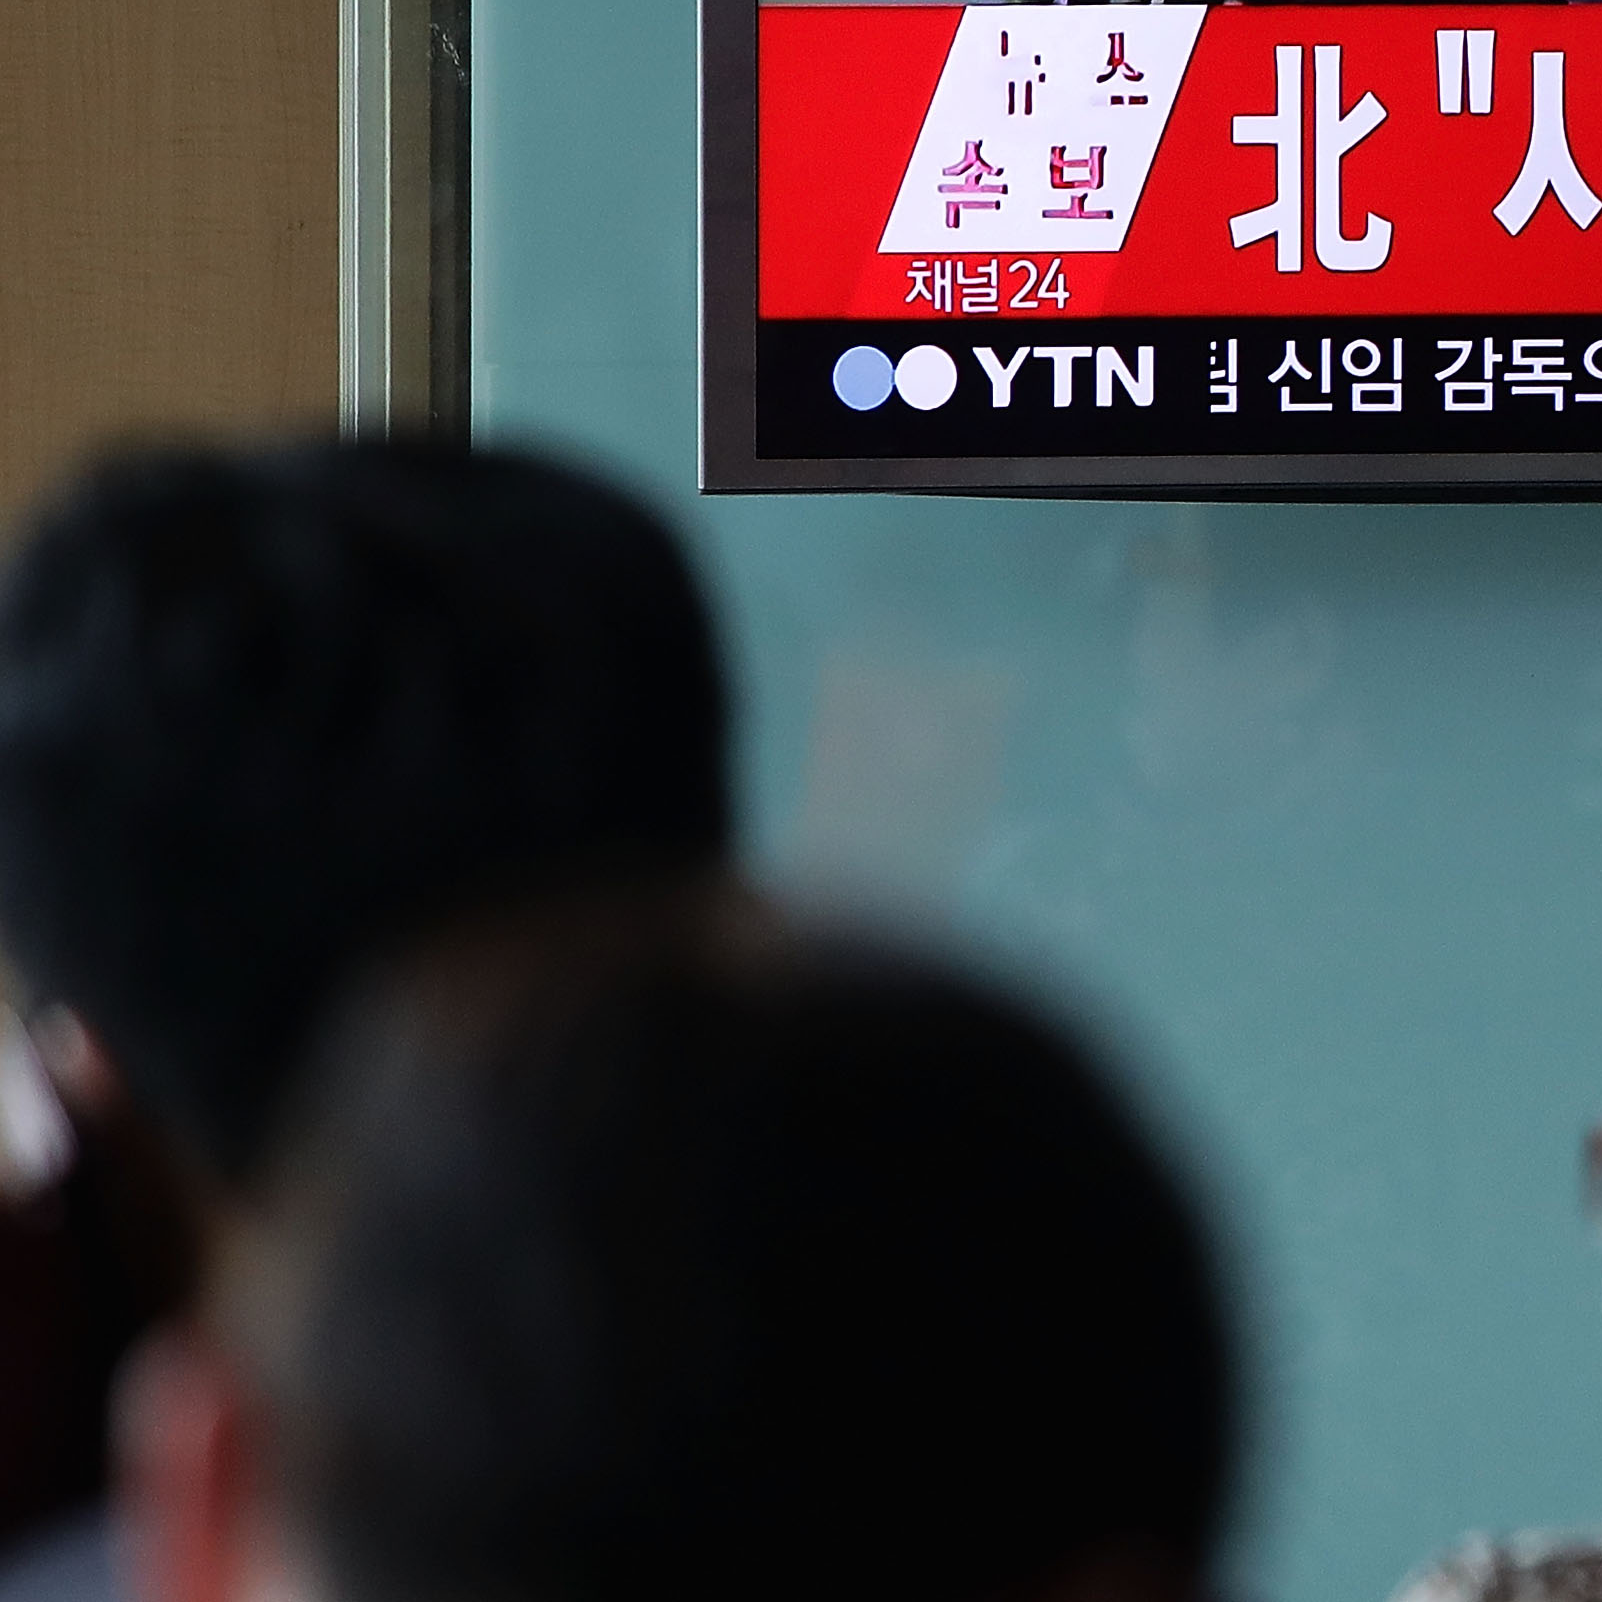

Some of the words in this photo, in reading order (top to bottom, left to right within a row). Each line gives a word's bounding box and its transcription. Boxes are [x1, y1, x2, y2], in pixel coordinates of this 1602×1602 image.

[937, 139, 1114, 229] 속보
[1228, 44, 1393, 273] 北
[972, 345, 1155, 408] YTN
[1267, 336, 1403, 412] 신임
